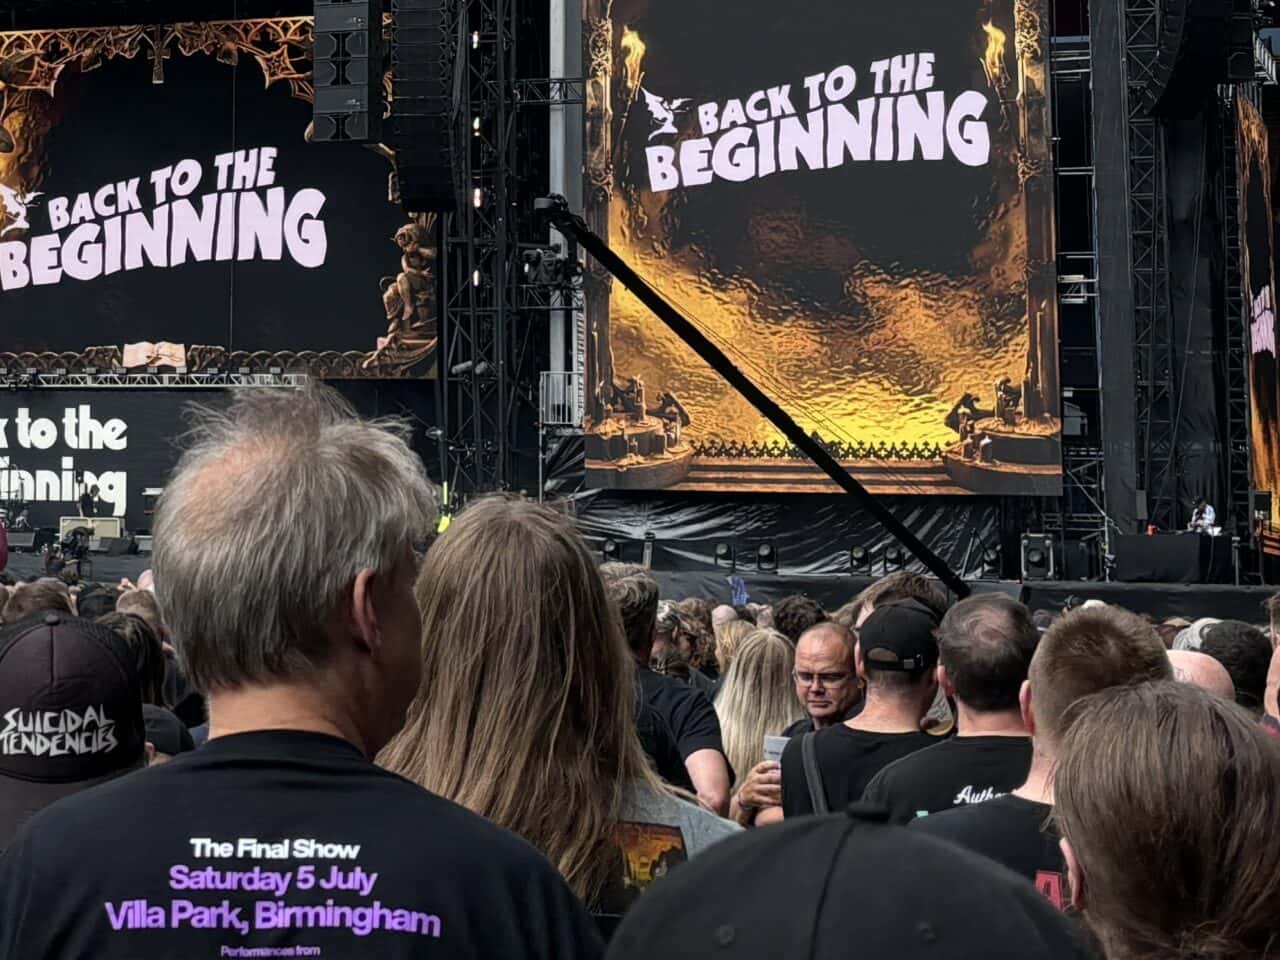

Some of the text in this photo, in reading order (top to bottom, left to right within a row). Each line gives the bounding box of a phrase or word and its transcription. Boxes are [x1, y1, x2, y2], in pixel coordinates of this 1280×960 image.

[697, 52, 936, 136] BACK TO THE
[645, 90, 990, 192] BEGINNING
[48, 146, 278, 232] BACK TO THE
[15, 407, 58, 450] to
[62, 404, 128, 451] the
[1, 703, 116, 734] SUICIDAL
[190, 838, 361, 859] The Final Show
[169, 864, 378, 896] Saturday 5 July
[104, 899, 441, 937] Villa Park, Birmingham
[220, 945, 320, 958] Performances from
